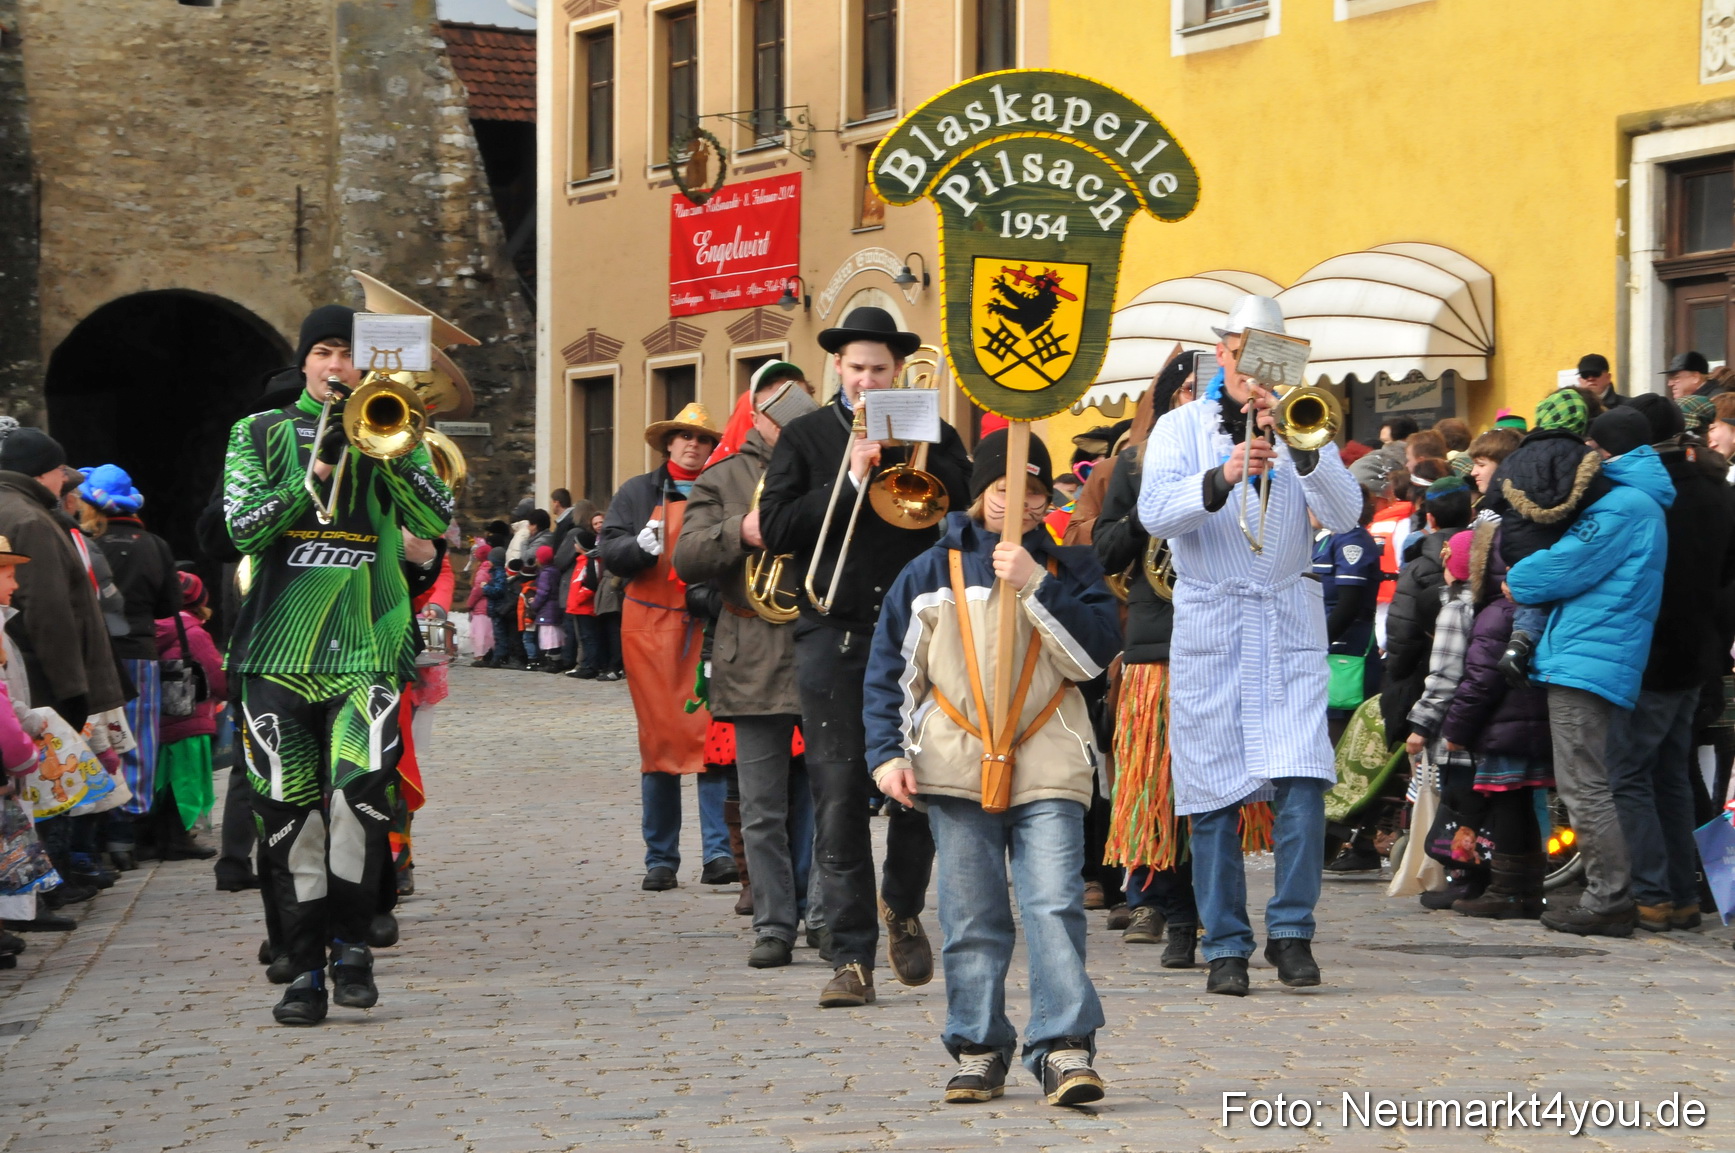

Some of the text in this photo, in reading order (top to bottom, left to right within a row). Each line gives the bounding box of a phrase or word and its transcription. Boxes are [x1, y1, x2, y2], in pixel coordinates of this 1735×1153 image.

[877, 83, 1179, 198] Blaskapelle
[937, 150, 1127, 231] Pilsach
[1000, 210, 1069, 241] 1954
[692, 224, 771, 275] Engelwirt
[282, 530, 319, 540] PRO
[287, 541, 376, 570] thor
[355, 802, 390, 821] thor
[268, 819, 296, 848] thor
